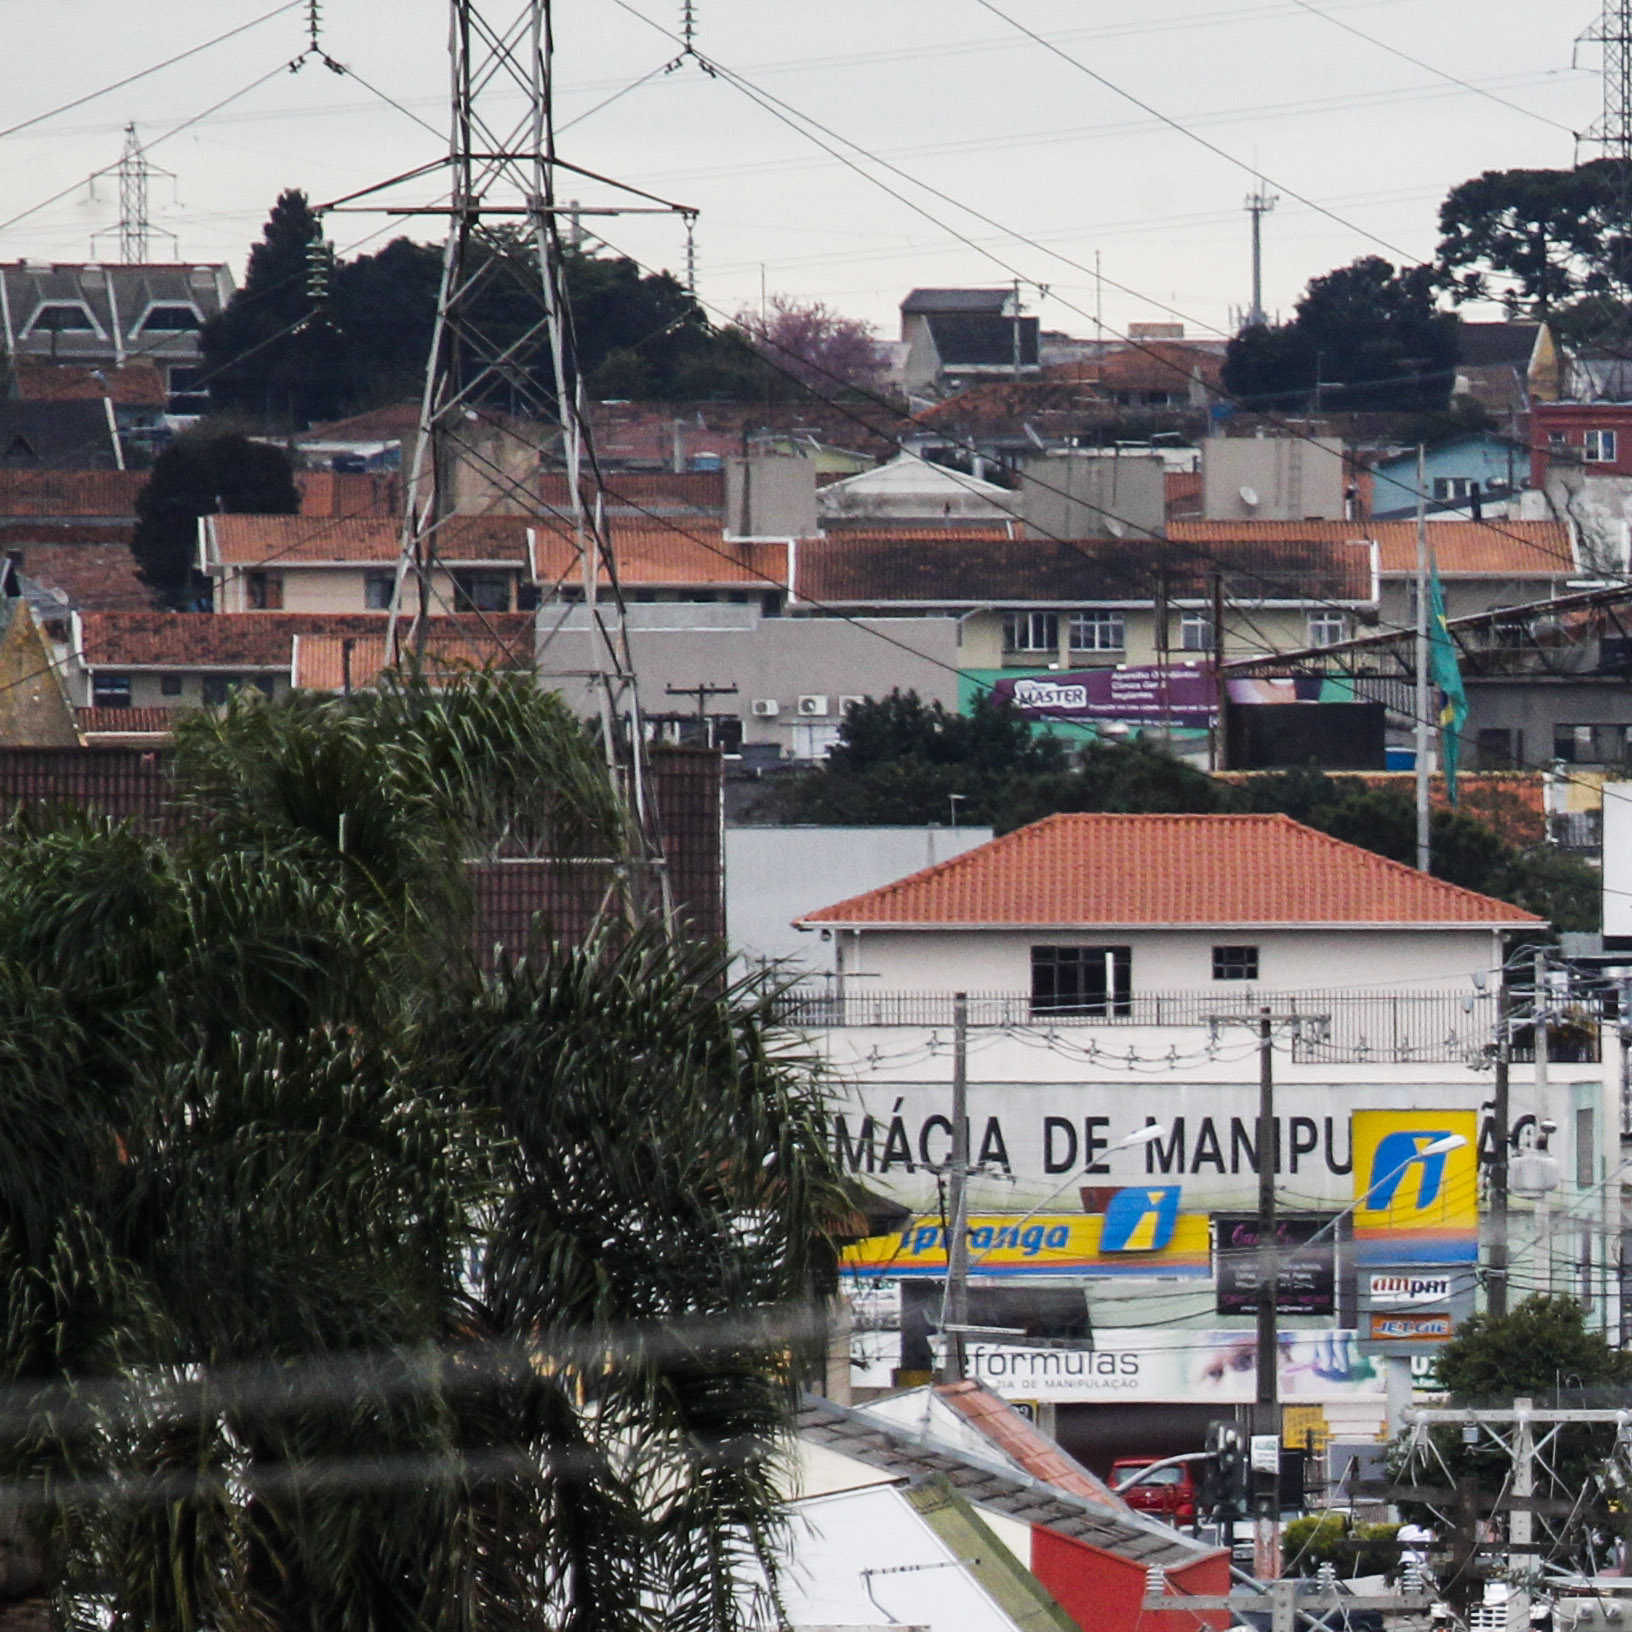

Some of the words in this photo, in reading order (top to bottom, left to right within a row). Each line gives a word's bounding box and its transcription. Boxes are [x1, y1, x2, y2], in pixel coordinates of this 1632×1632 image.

[1019, 687, 1084, 705] MASTER
[1043, 1116, 1110, 1174] DE
[1022, 1379, 1038, 1389] DE
[1045, 1377, 1139, 1391] MANIPULAÇÃO
